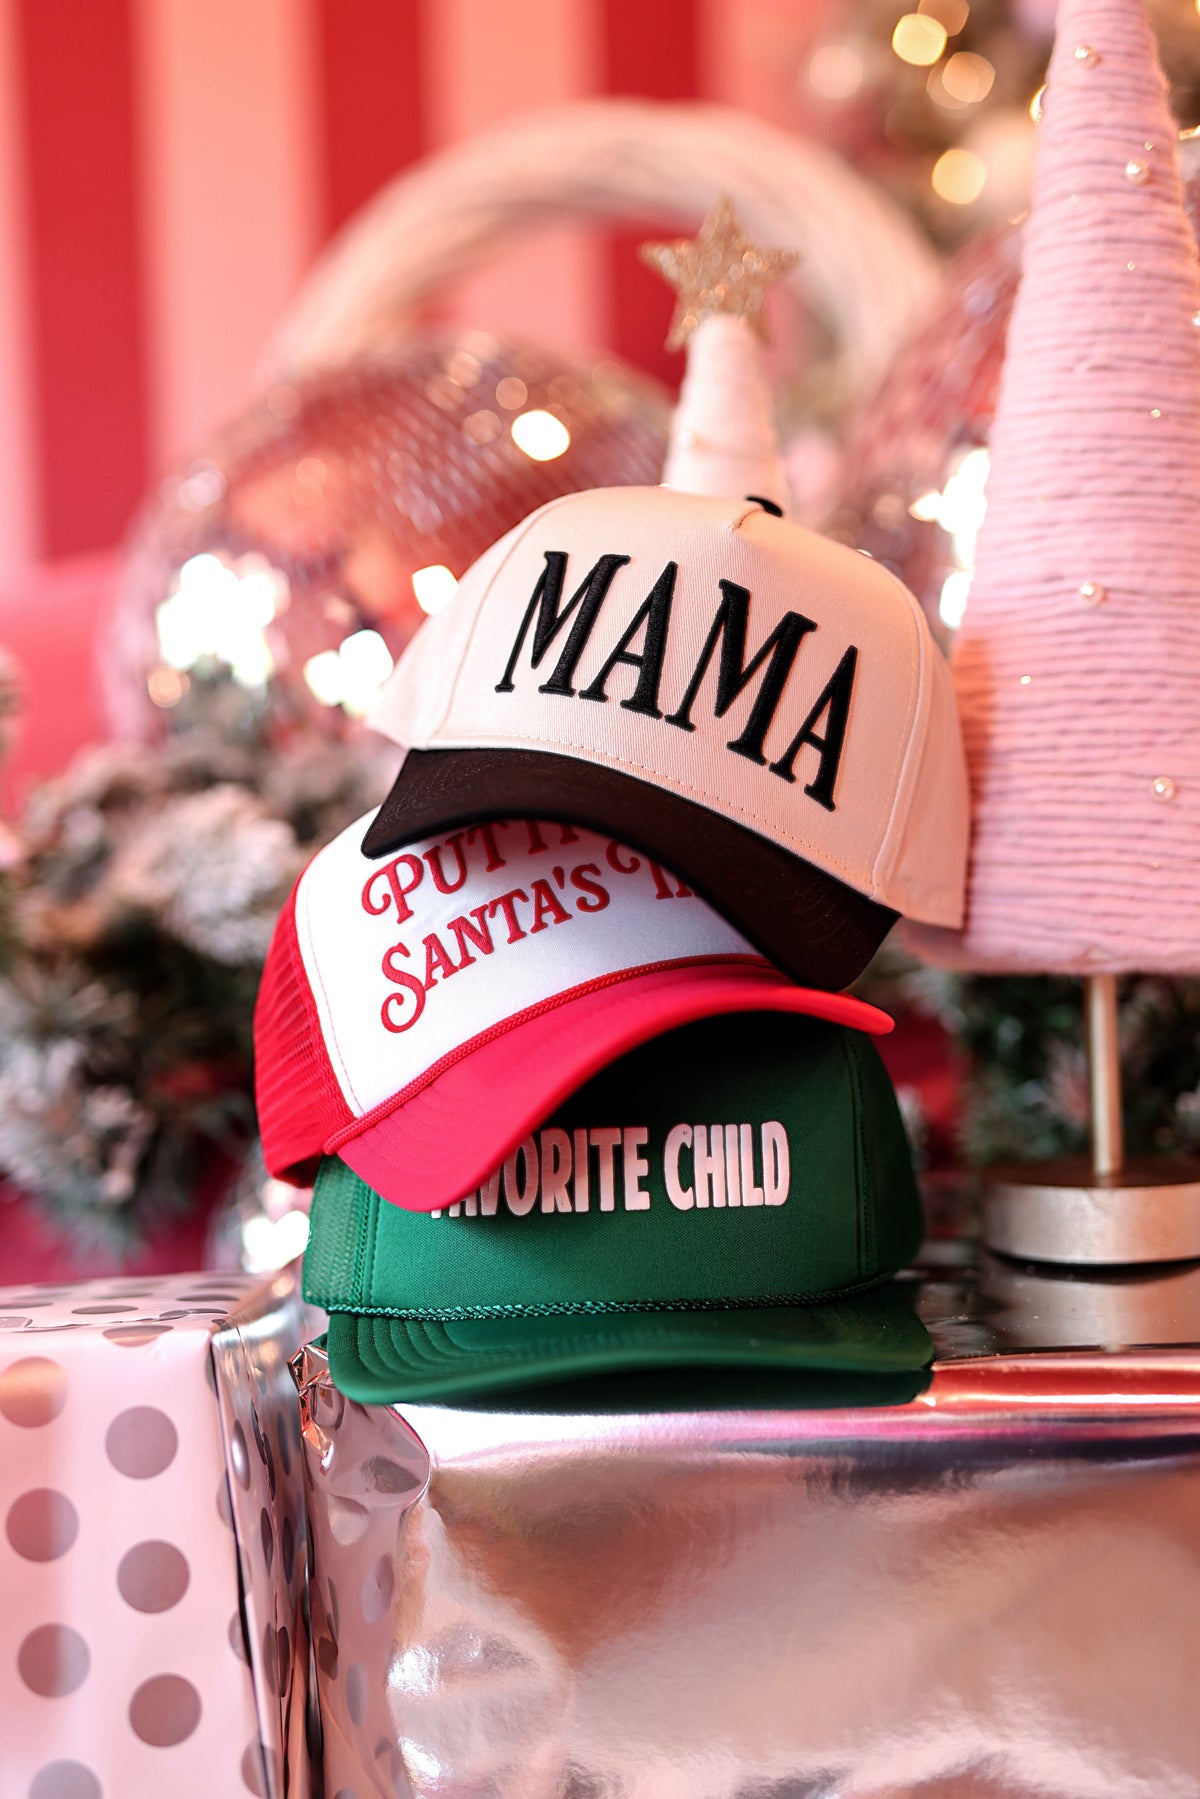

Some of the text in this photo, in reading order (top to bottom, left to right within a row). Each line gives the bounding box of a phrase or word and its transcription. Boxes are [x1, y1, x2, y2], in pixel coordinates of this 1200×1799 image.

[495, 551, 858, 812] MAMA
[361, 821, 510, 925] PUT
[380, 862, 611, 1034] SANTA'S
[430, 1120, 791, 1219] ORITE CHILD
